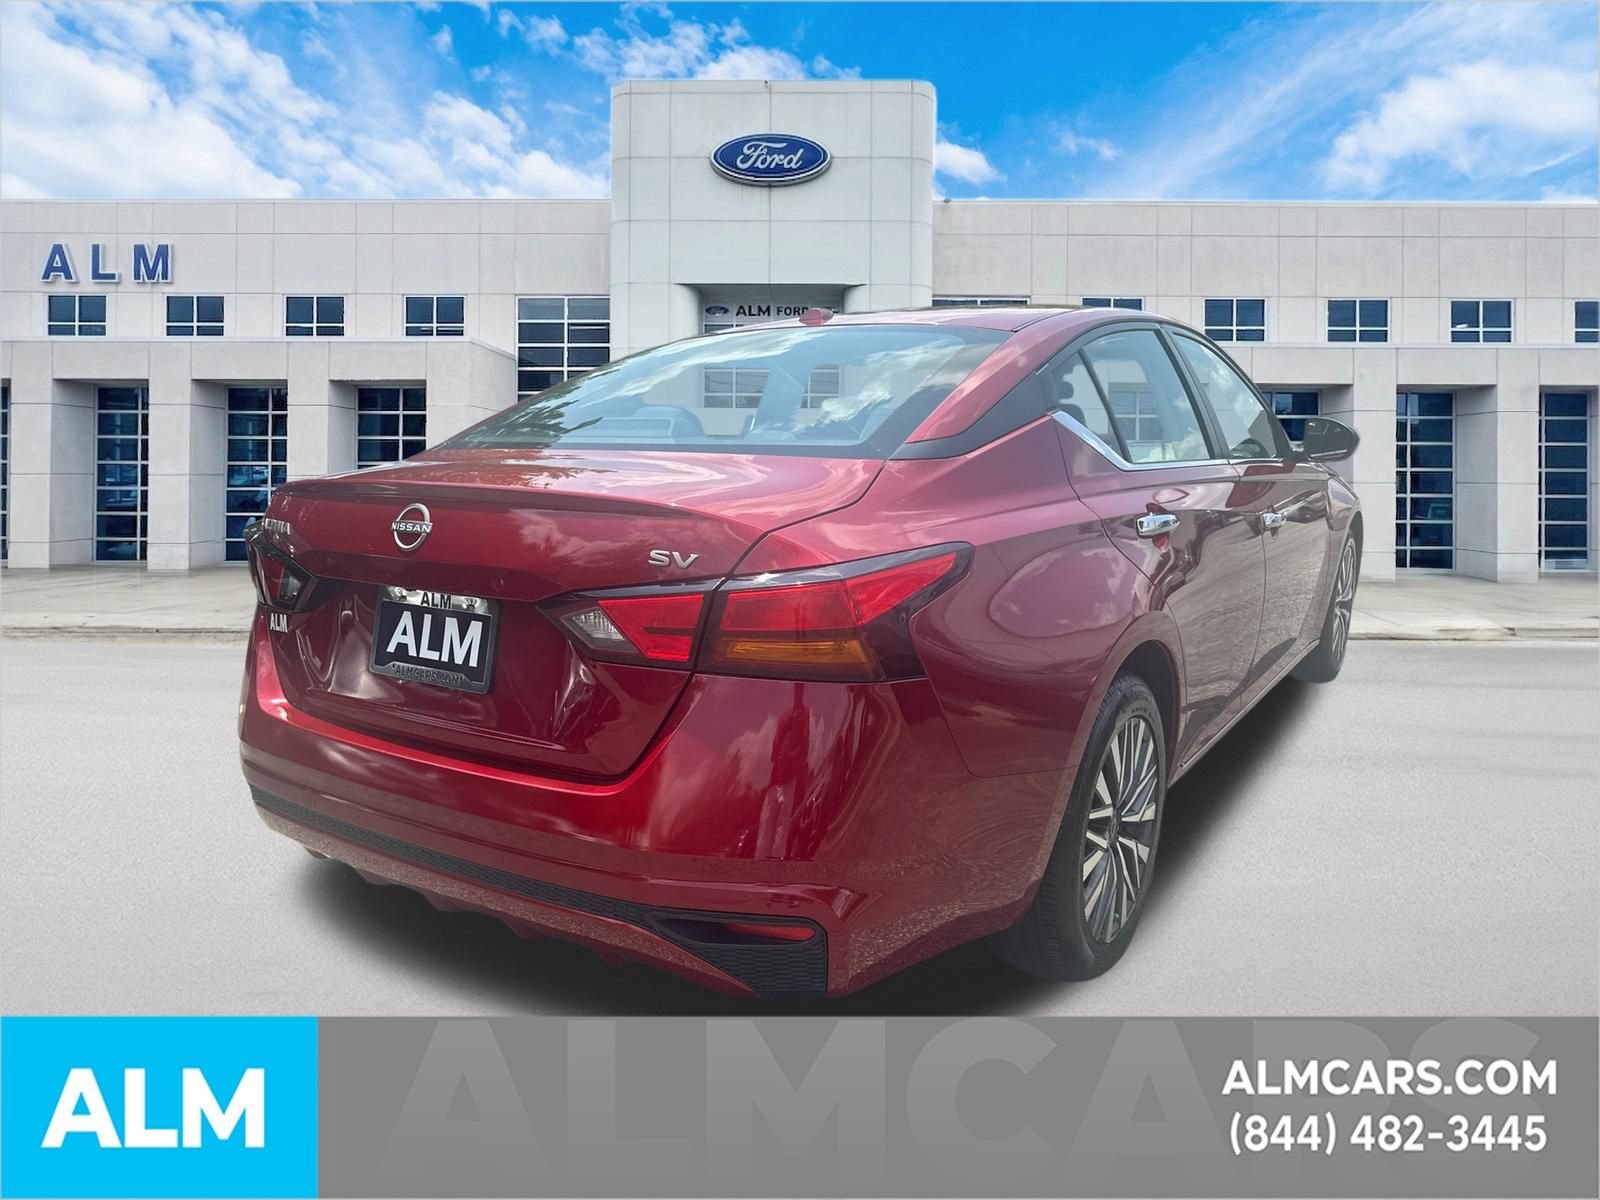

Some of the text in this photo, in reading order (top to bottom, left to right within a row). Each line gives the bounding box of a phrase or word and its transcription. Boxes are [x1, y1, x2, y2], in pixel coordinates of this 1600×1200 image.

[736, 141, 804, 169] Ford
[42, 243, 170, 281] ALM
[736, 305, 770, 316] ALM
[392, 522, 431, 533] NISSAN
[648, 549, 699, 569] SV
[420, 591, 452, 609] ALM
[270, 612, 288, 633] ALM
[386, 610, 483, 667] ALM
